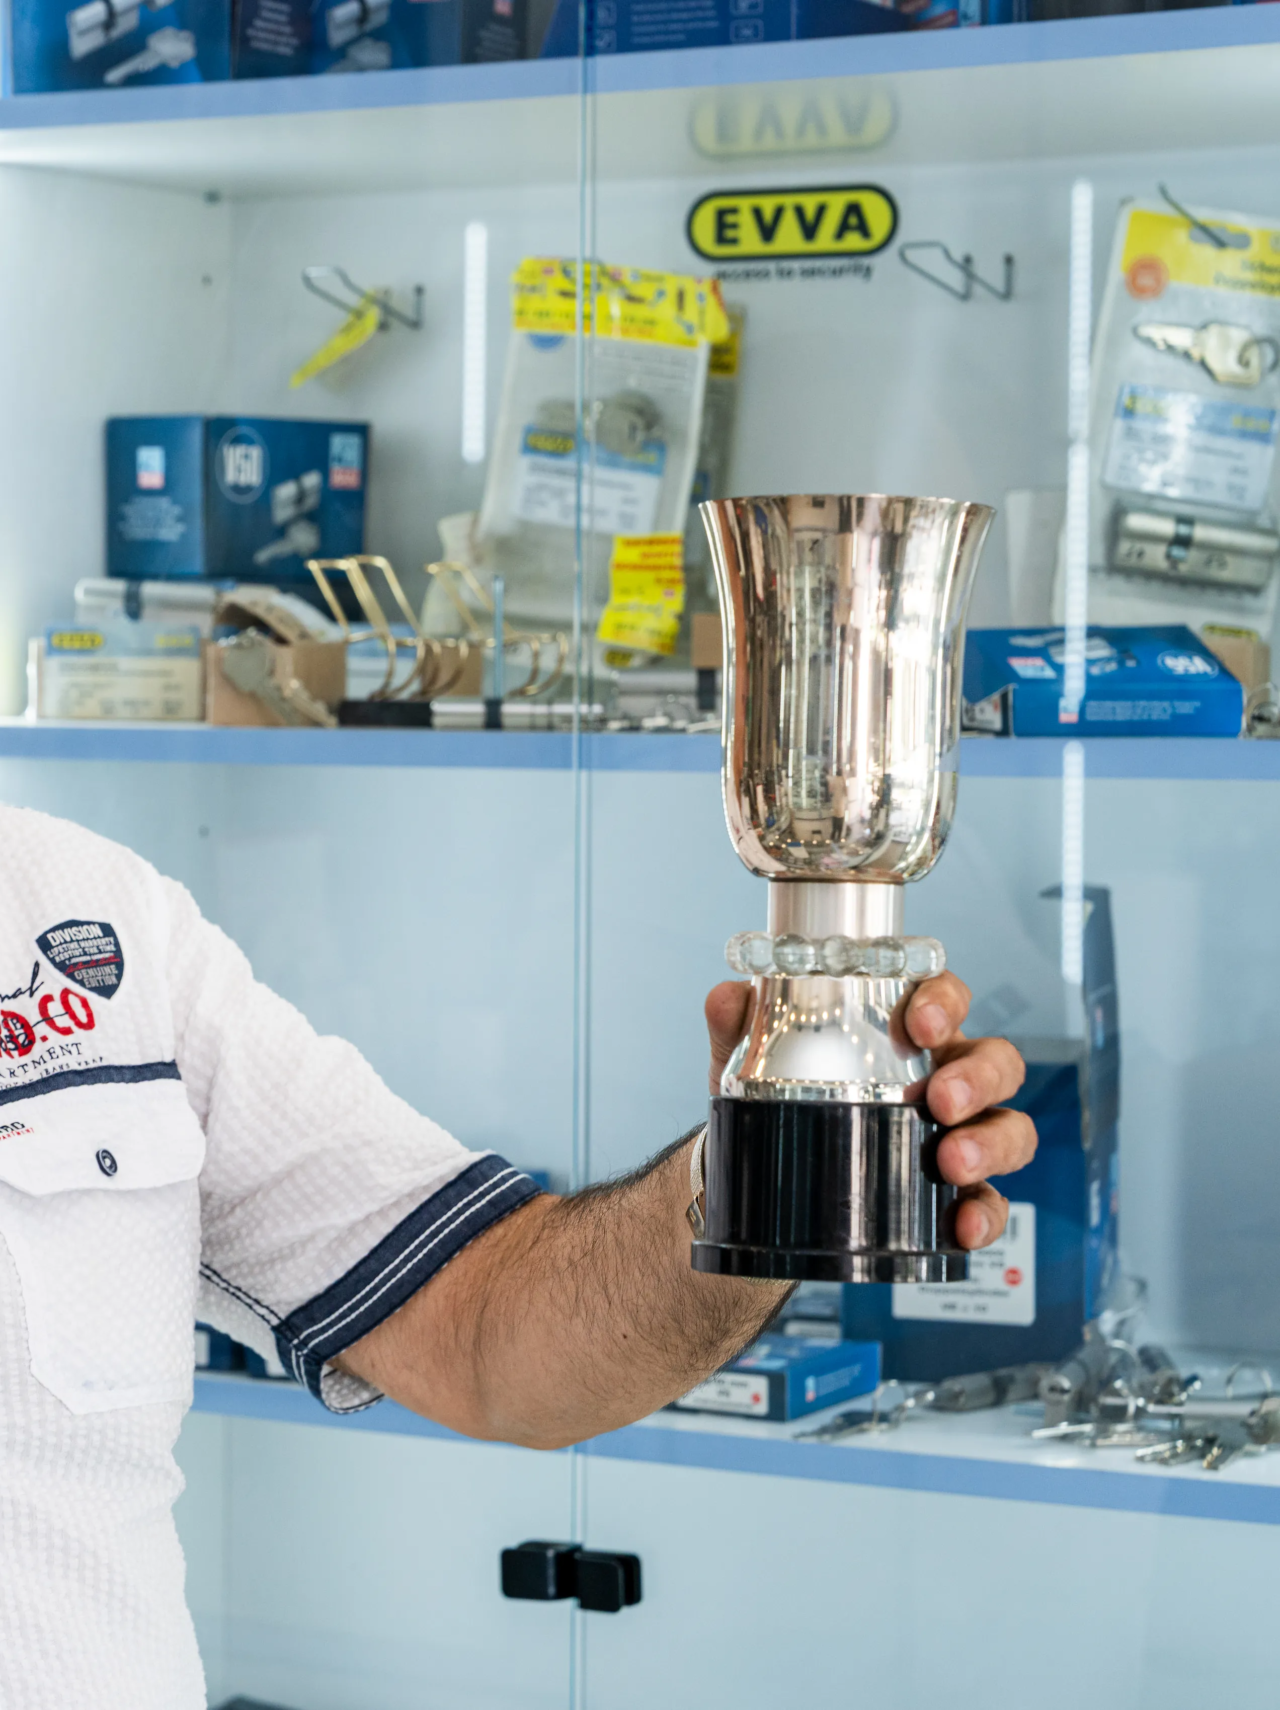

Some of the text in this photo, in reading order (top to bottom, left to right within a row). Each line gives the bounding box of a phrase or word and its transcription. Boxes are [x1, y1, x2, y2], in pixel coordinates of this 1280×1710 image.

[714, 201, 872, 246] EVVA
[46, 923, 104, 947] DIVISION
[74, 964, 118, 980] GENUINE
[83, 975, 118, 989] EDITION
